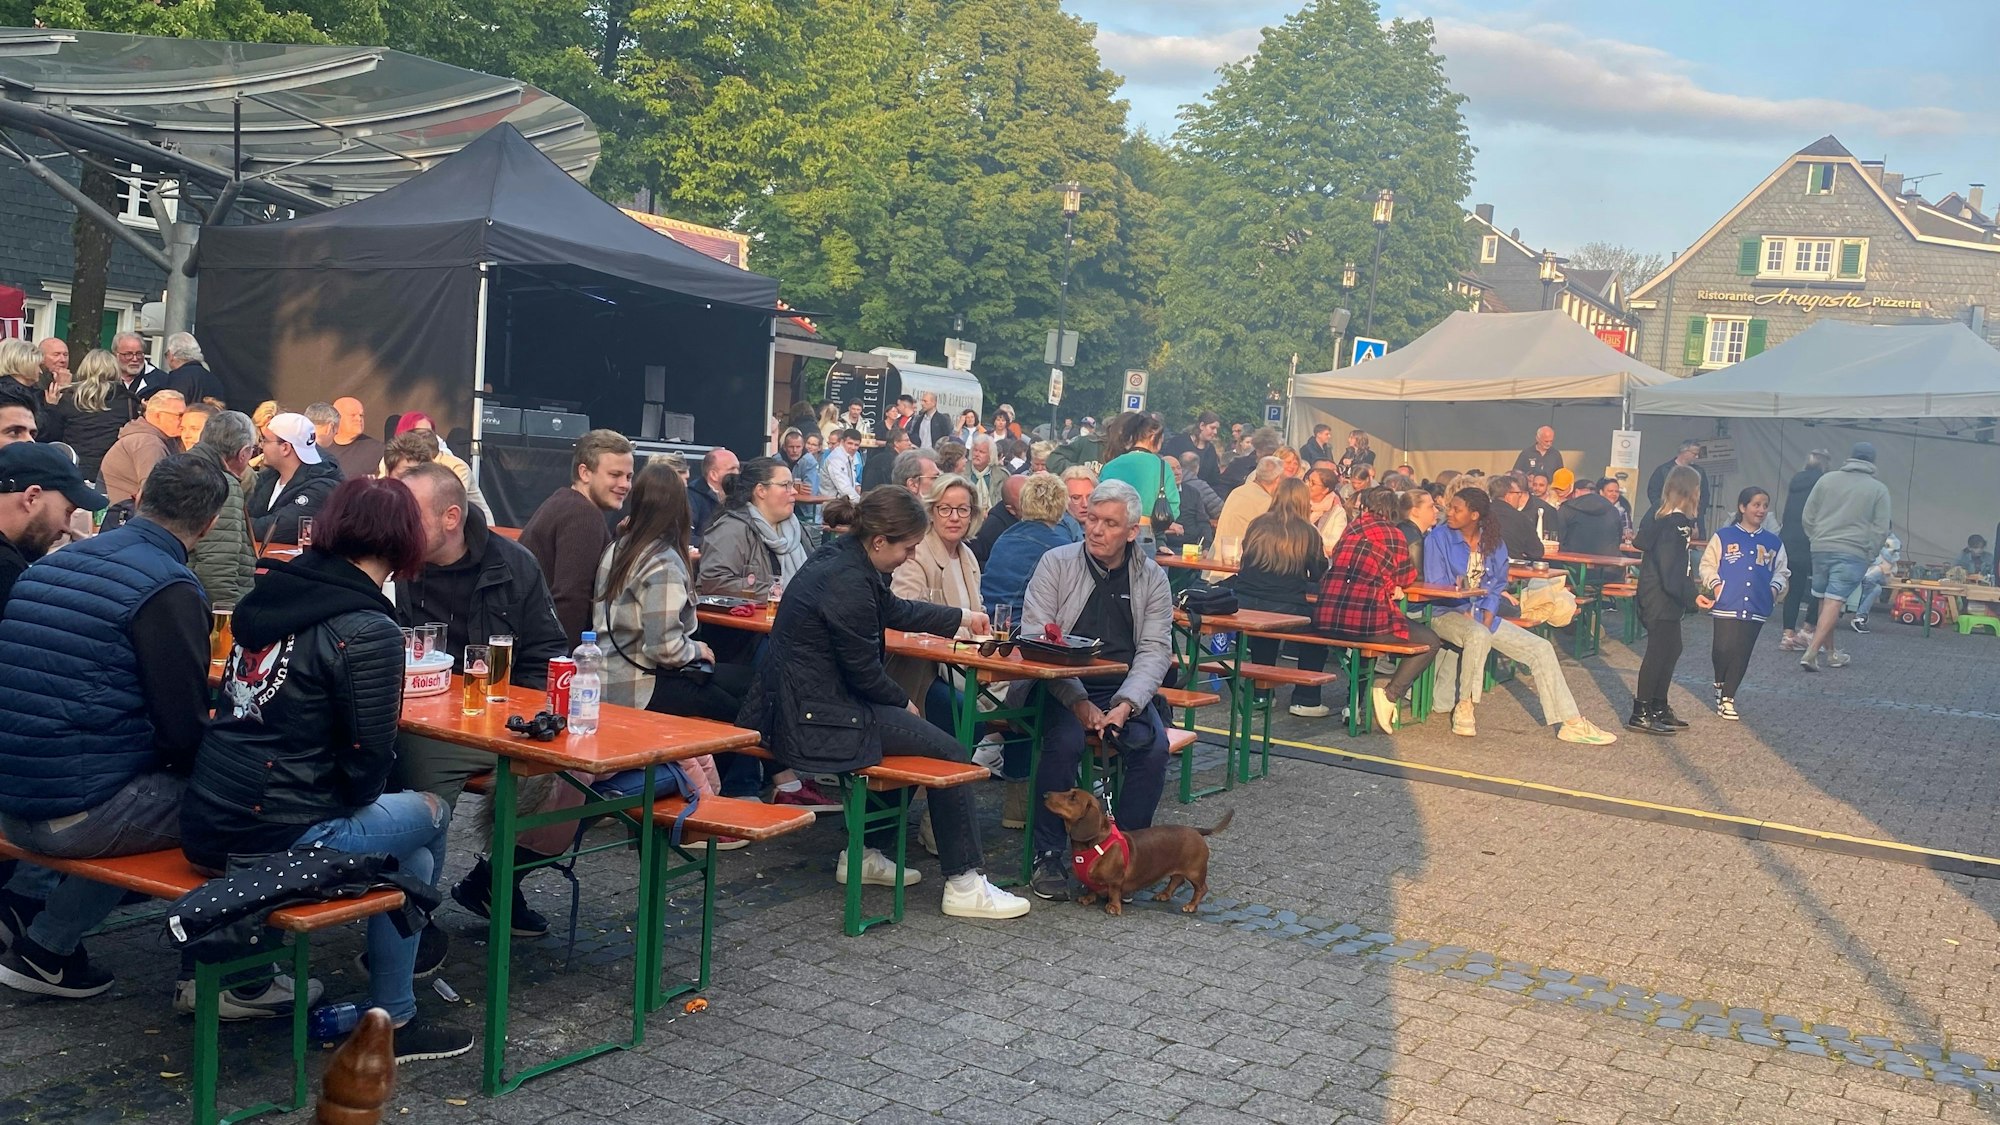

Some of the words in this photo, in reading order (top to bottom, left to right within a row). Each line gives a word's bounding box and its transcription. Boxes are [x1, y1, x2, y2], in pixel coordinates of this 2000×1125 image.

[1697, 289, 1755, 302] Ristorante
[1755, 287, 1872, 313] Aragosta
[1872, 296, 1922, 309] Pizzeria
[257, 656, 290, 706] PUNCH
[411, 674, 441, 689] Kölsch
